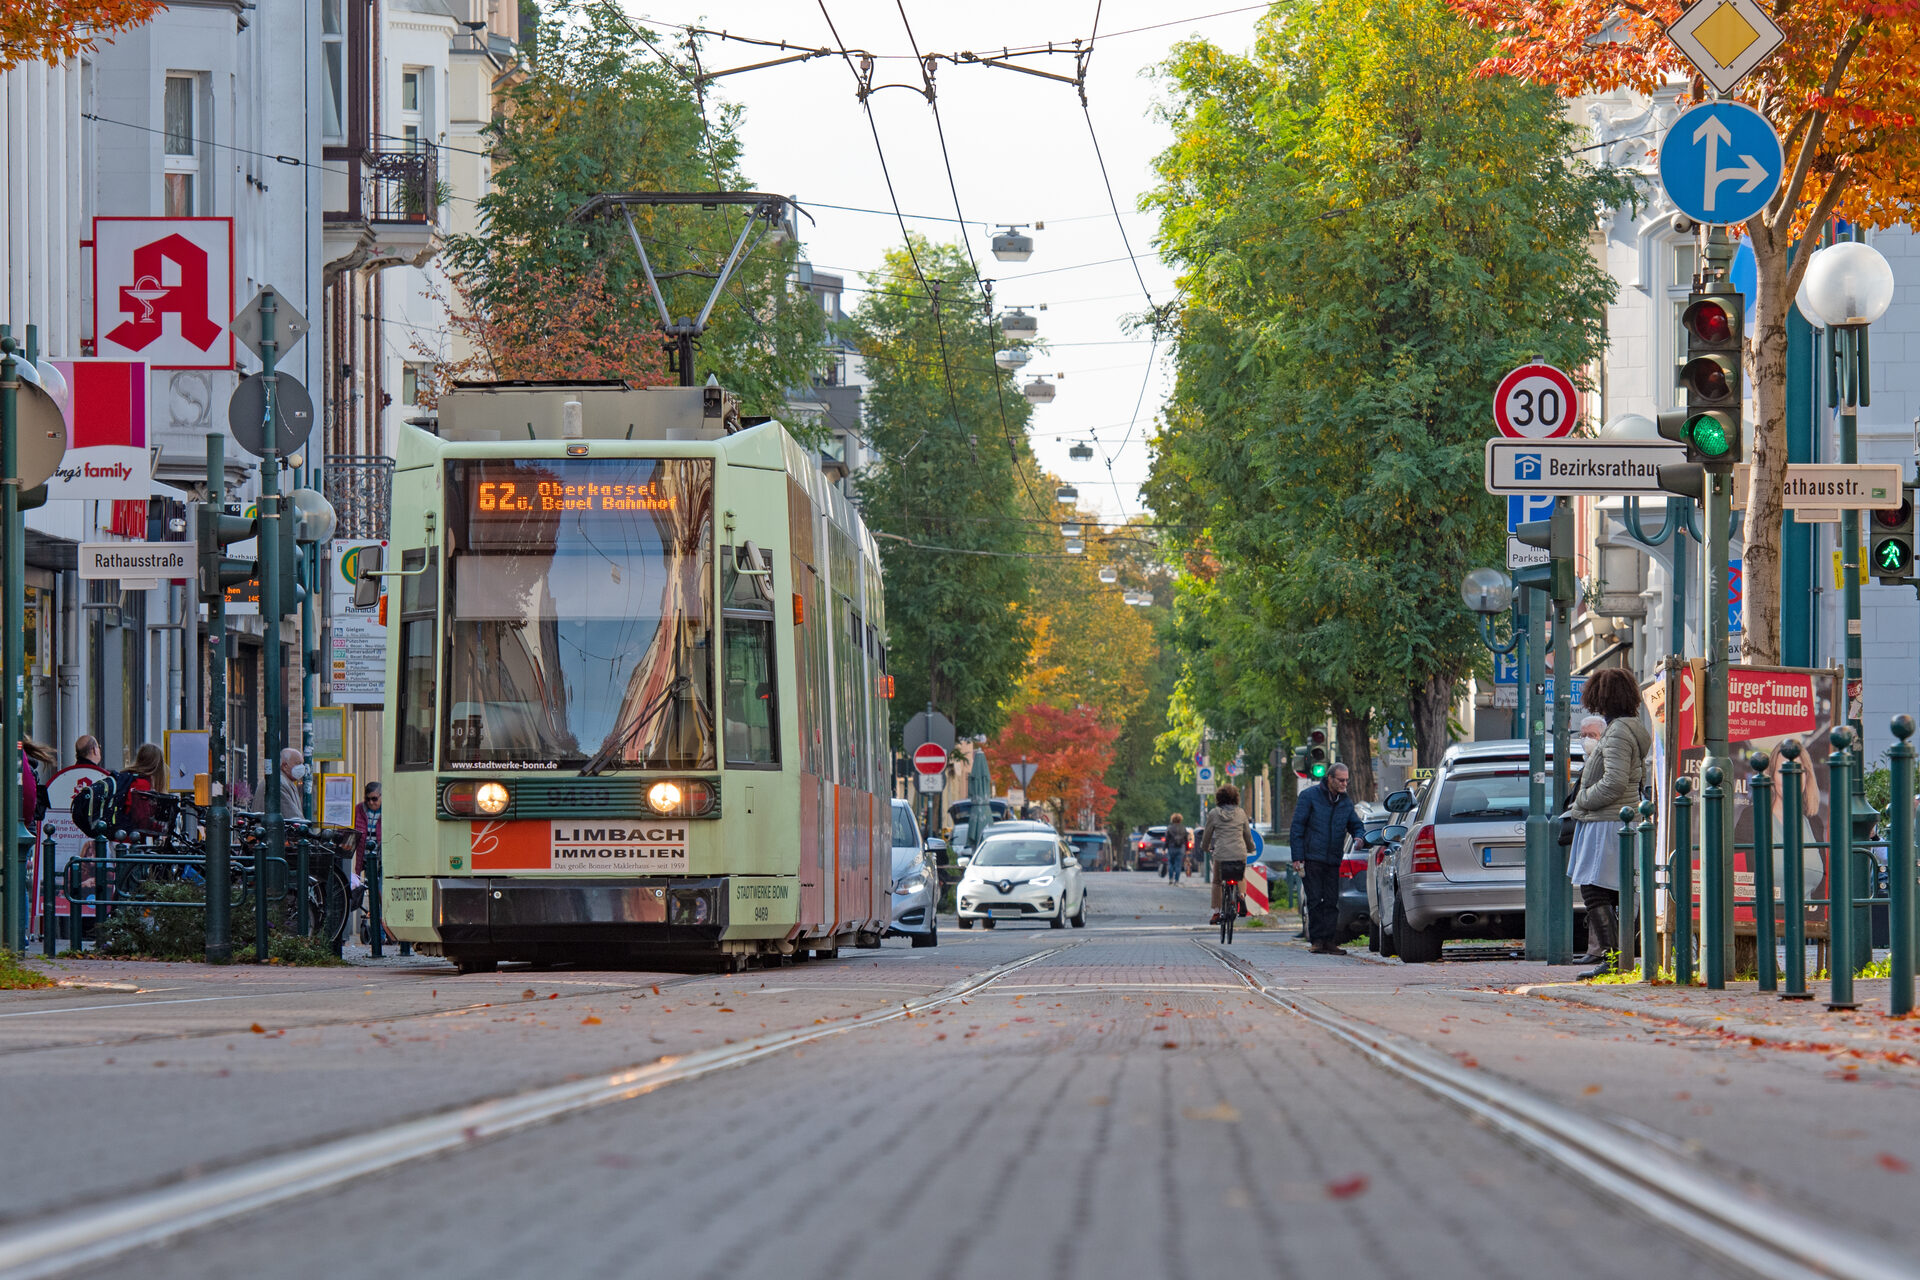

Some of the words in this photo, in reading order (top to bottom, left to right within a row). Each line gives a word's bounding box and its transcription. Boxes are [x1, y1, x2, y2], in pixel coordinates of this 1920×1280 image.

[1513, 388, 1559, 427] 30
[51, 466, 82, 483] ing's
[84, 461, 133, 482] family
[1783, 477, 1865, 496] athausstr.
[479, 482, 516, 511] 62
[538, 482, 658, 496] Oberkassel
[541, 496, 594, 511] Beuel
[602, 495, 678, 511] Bahnhof
[231, 504, 240, 512] 65
[95, 552, 184, 568] Rathausstraße
[1728, 678, 1808, 699] ürgerinnen
[1728, 697, 1809, 717] prechstunde
[451, 760, 559, 770] www.stadtwerke-bonn.de
[1418, 769, 1432, 778] TA
[554, 828, 685, 841] LIMBACH
[554, 848, 685, 859] IMMOBILIEN
[554, 862, 568, 870] Das
[567, 862, 587, 871] große
[588, 862, 612, 870] Bonner
[613, 862, 649, 870] Maklerhaus
[670, 863, 685, 871] 1959
[736, 884, 772, 900] STADTWERKE
[772, 884, 789, 900] BONN
[754, 906, 769, 922] 9469
